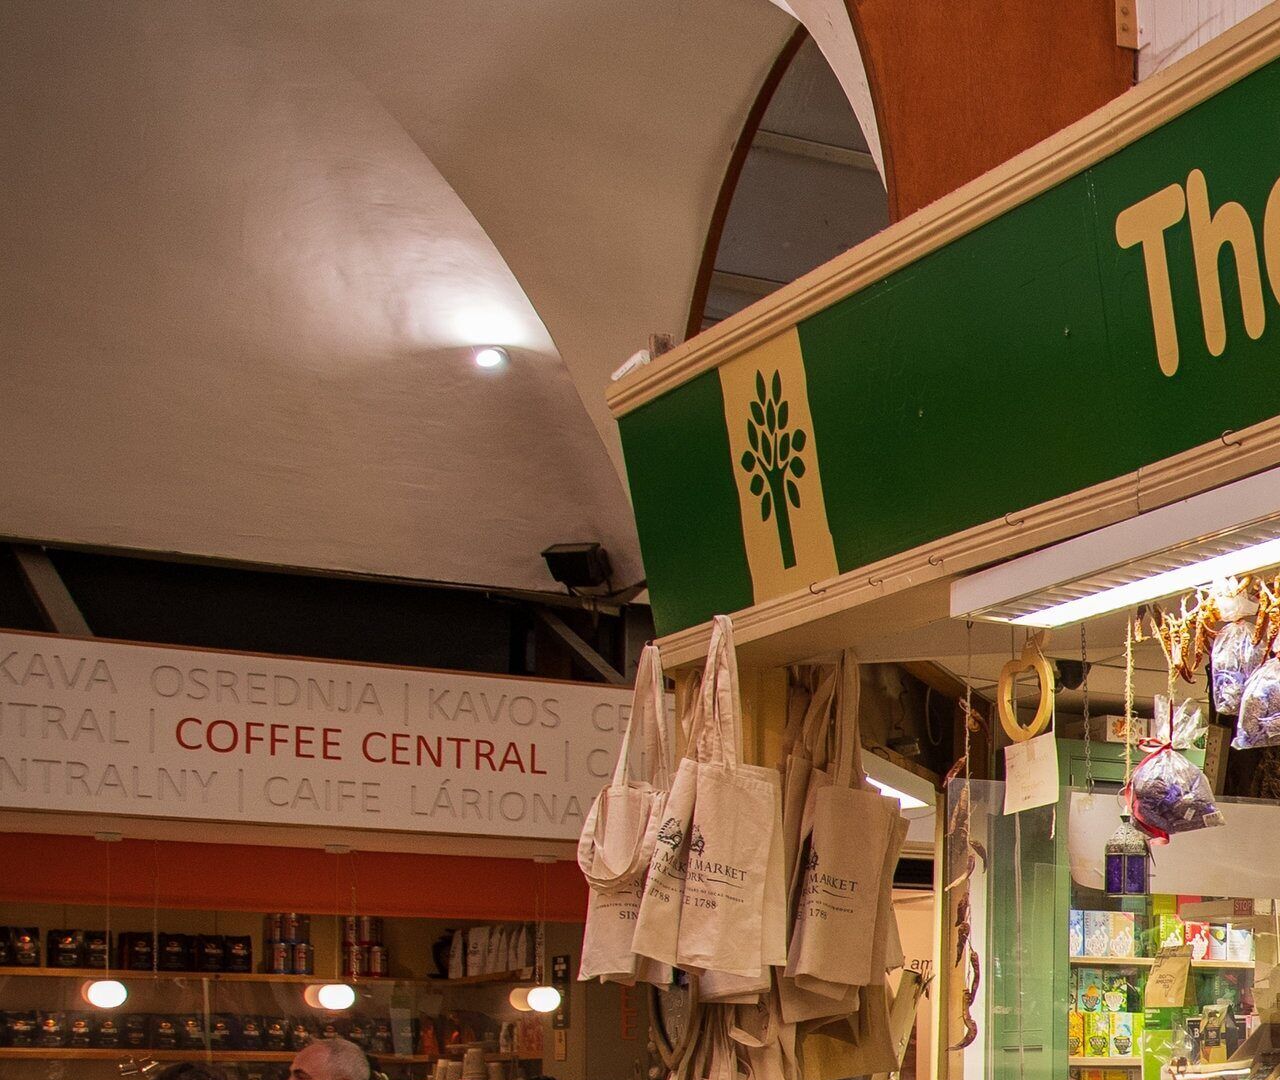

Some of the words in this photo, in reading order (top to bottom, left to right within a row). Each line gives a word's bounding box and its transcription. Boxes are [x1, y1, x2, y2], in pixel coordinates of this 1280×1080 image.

[152, 664, 385, 718] OSREDNJA
[427, 687, 562, 729] KAVOS
[174, 716, 343, 761] COFFEE
[361, 730, 549, 776] CENTRAL
[263, 775, 382, 815] CAIFE
[410, 778, 600, 826] LÁRIONA
[694, 860, 748, 882] MARKET
[809, 873, 858, 893] MARKET
[694, 897, 718, 910] 1788
